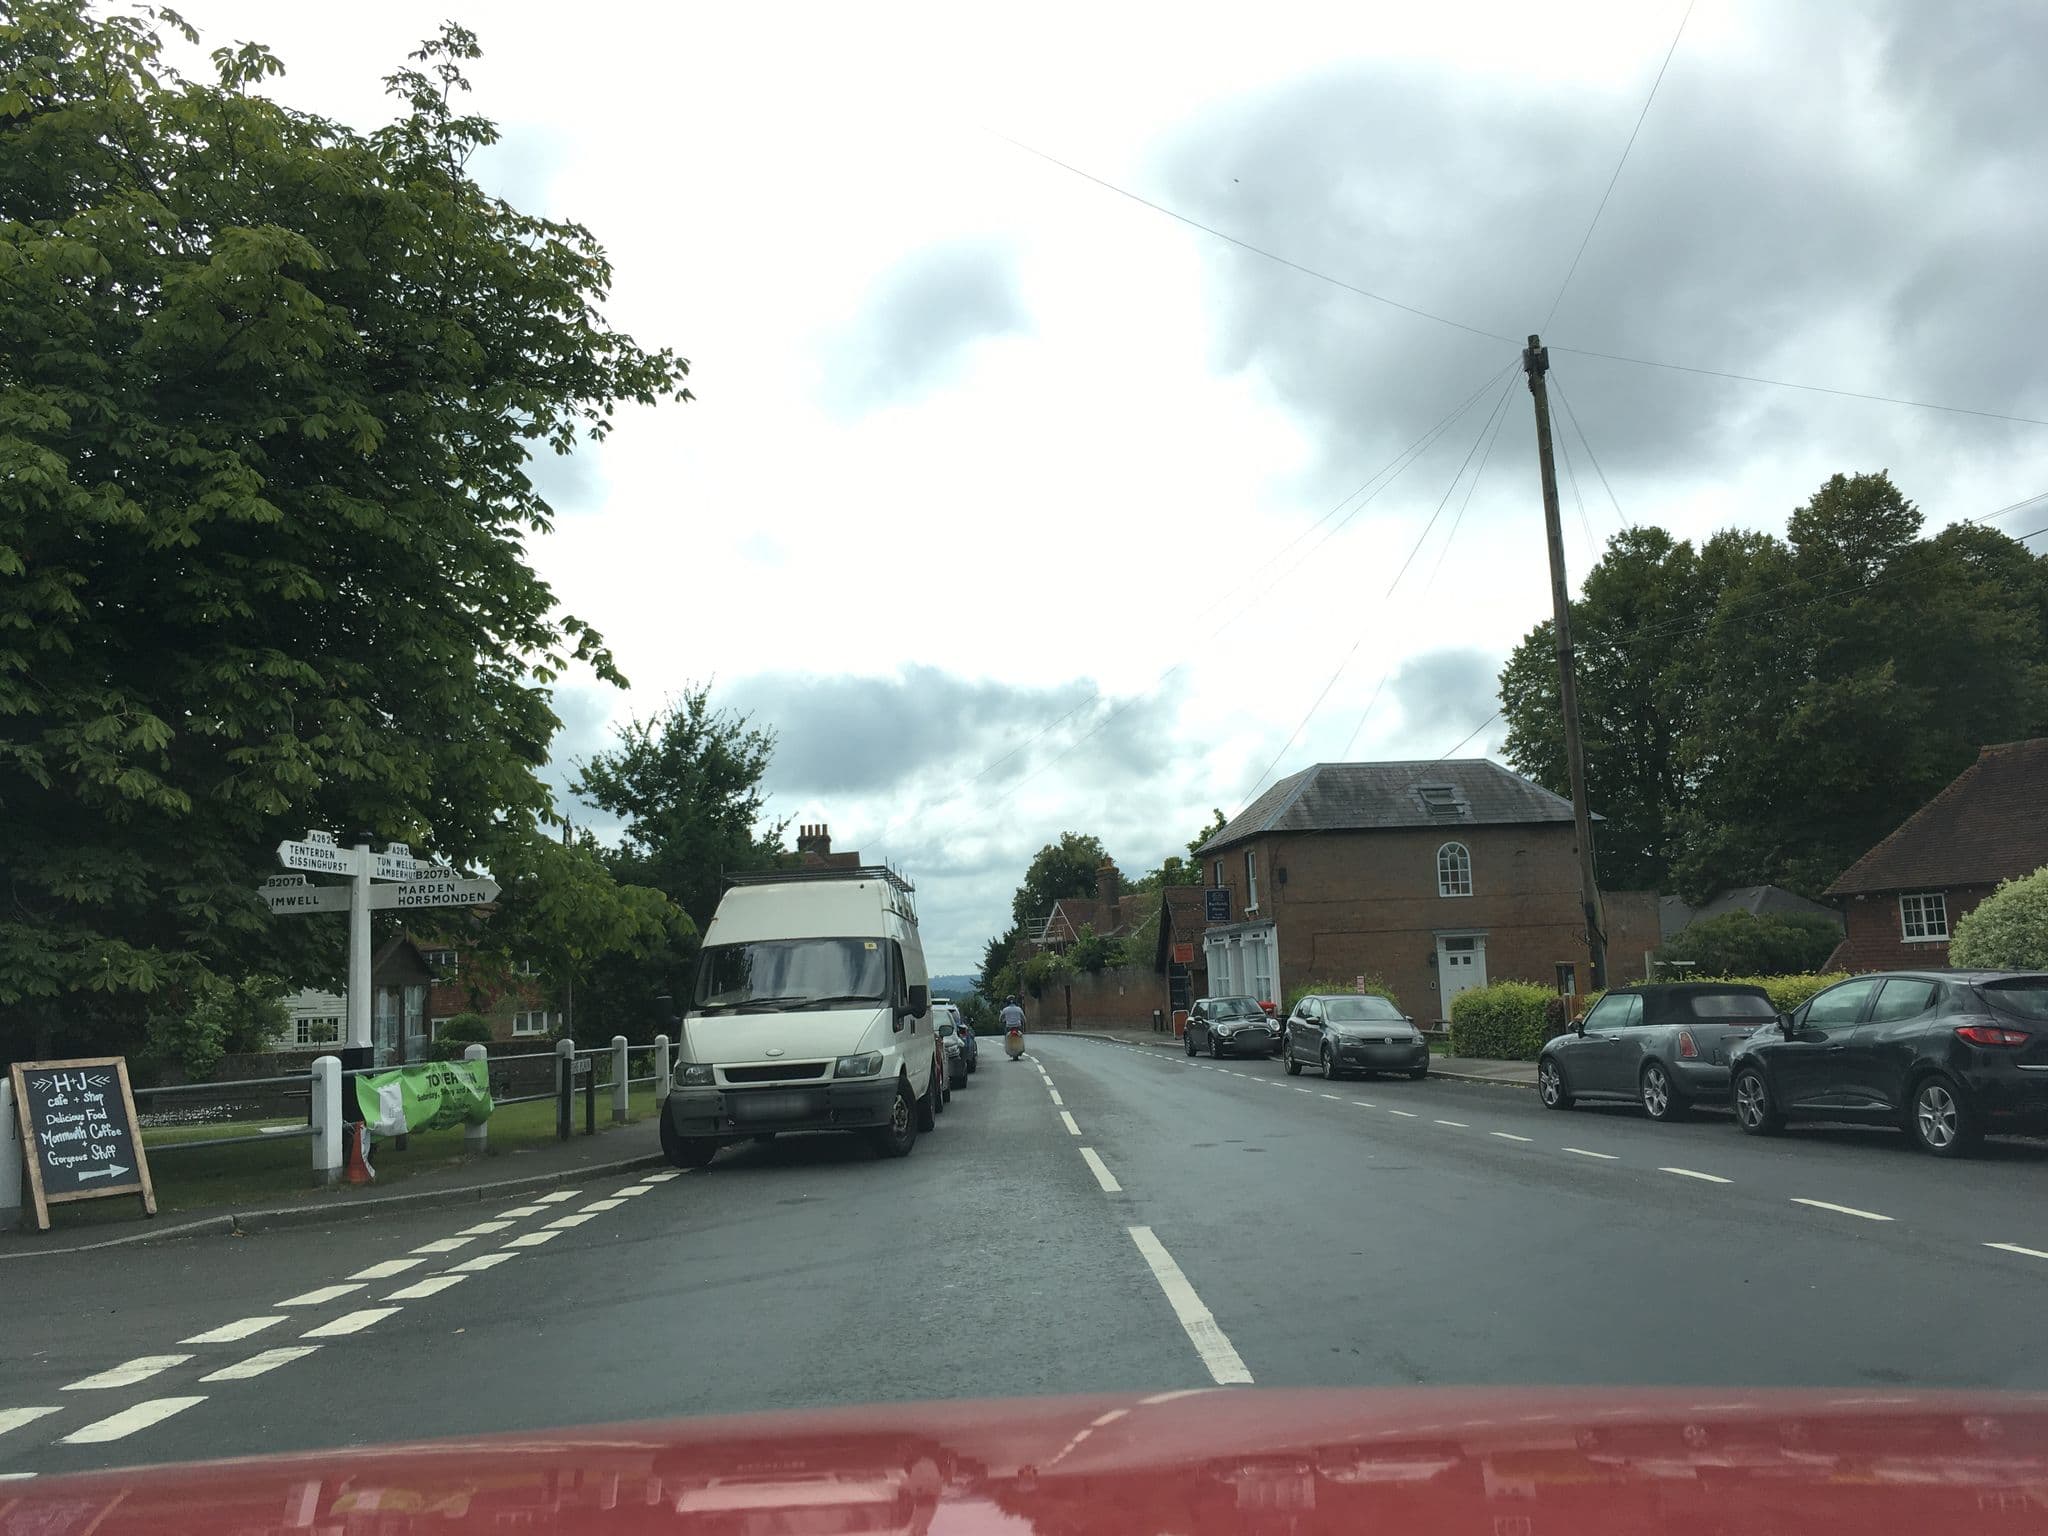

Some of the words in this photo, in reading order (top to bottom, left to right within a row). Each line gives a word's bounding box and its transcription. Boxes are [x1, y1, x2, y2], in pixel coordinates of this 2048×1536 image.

[311, 833, 331, 845] A262
[289, 844, 335, 859] TENTERDEN
[392, 845, 409, 856] A262
[289, 855, 347, 872] SISSINGHURST
[377, 856, 391, 867] TUN
[396, 859, 417, 870] WELLS
[416, 869, 450, 880] B2079
[268, 877, 304, 888] B2079
[398, 883, 455, 895] MARDEN
[398, 891, 486, 906] HORSMONDEN
[46, 1111, 85, 1125] Delicious
[86, 1107, 108, 1121] Food
[40, 1125, 88, 1148] Monmouth
[89, 1122, 122, 1139] Coffee
[47, 1150, 88, 1168] Gorgeous
[91, 1144, 117, 1160] Stuff
